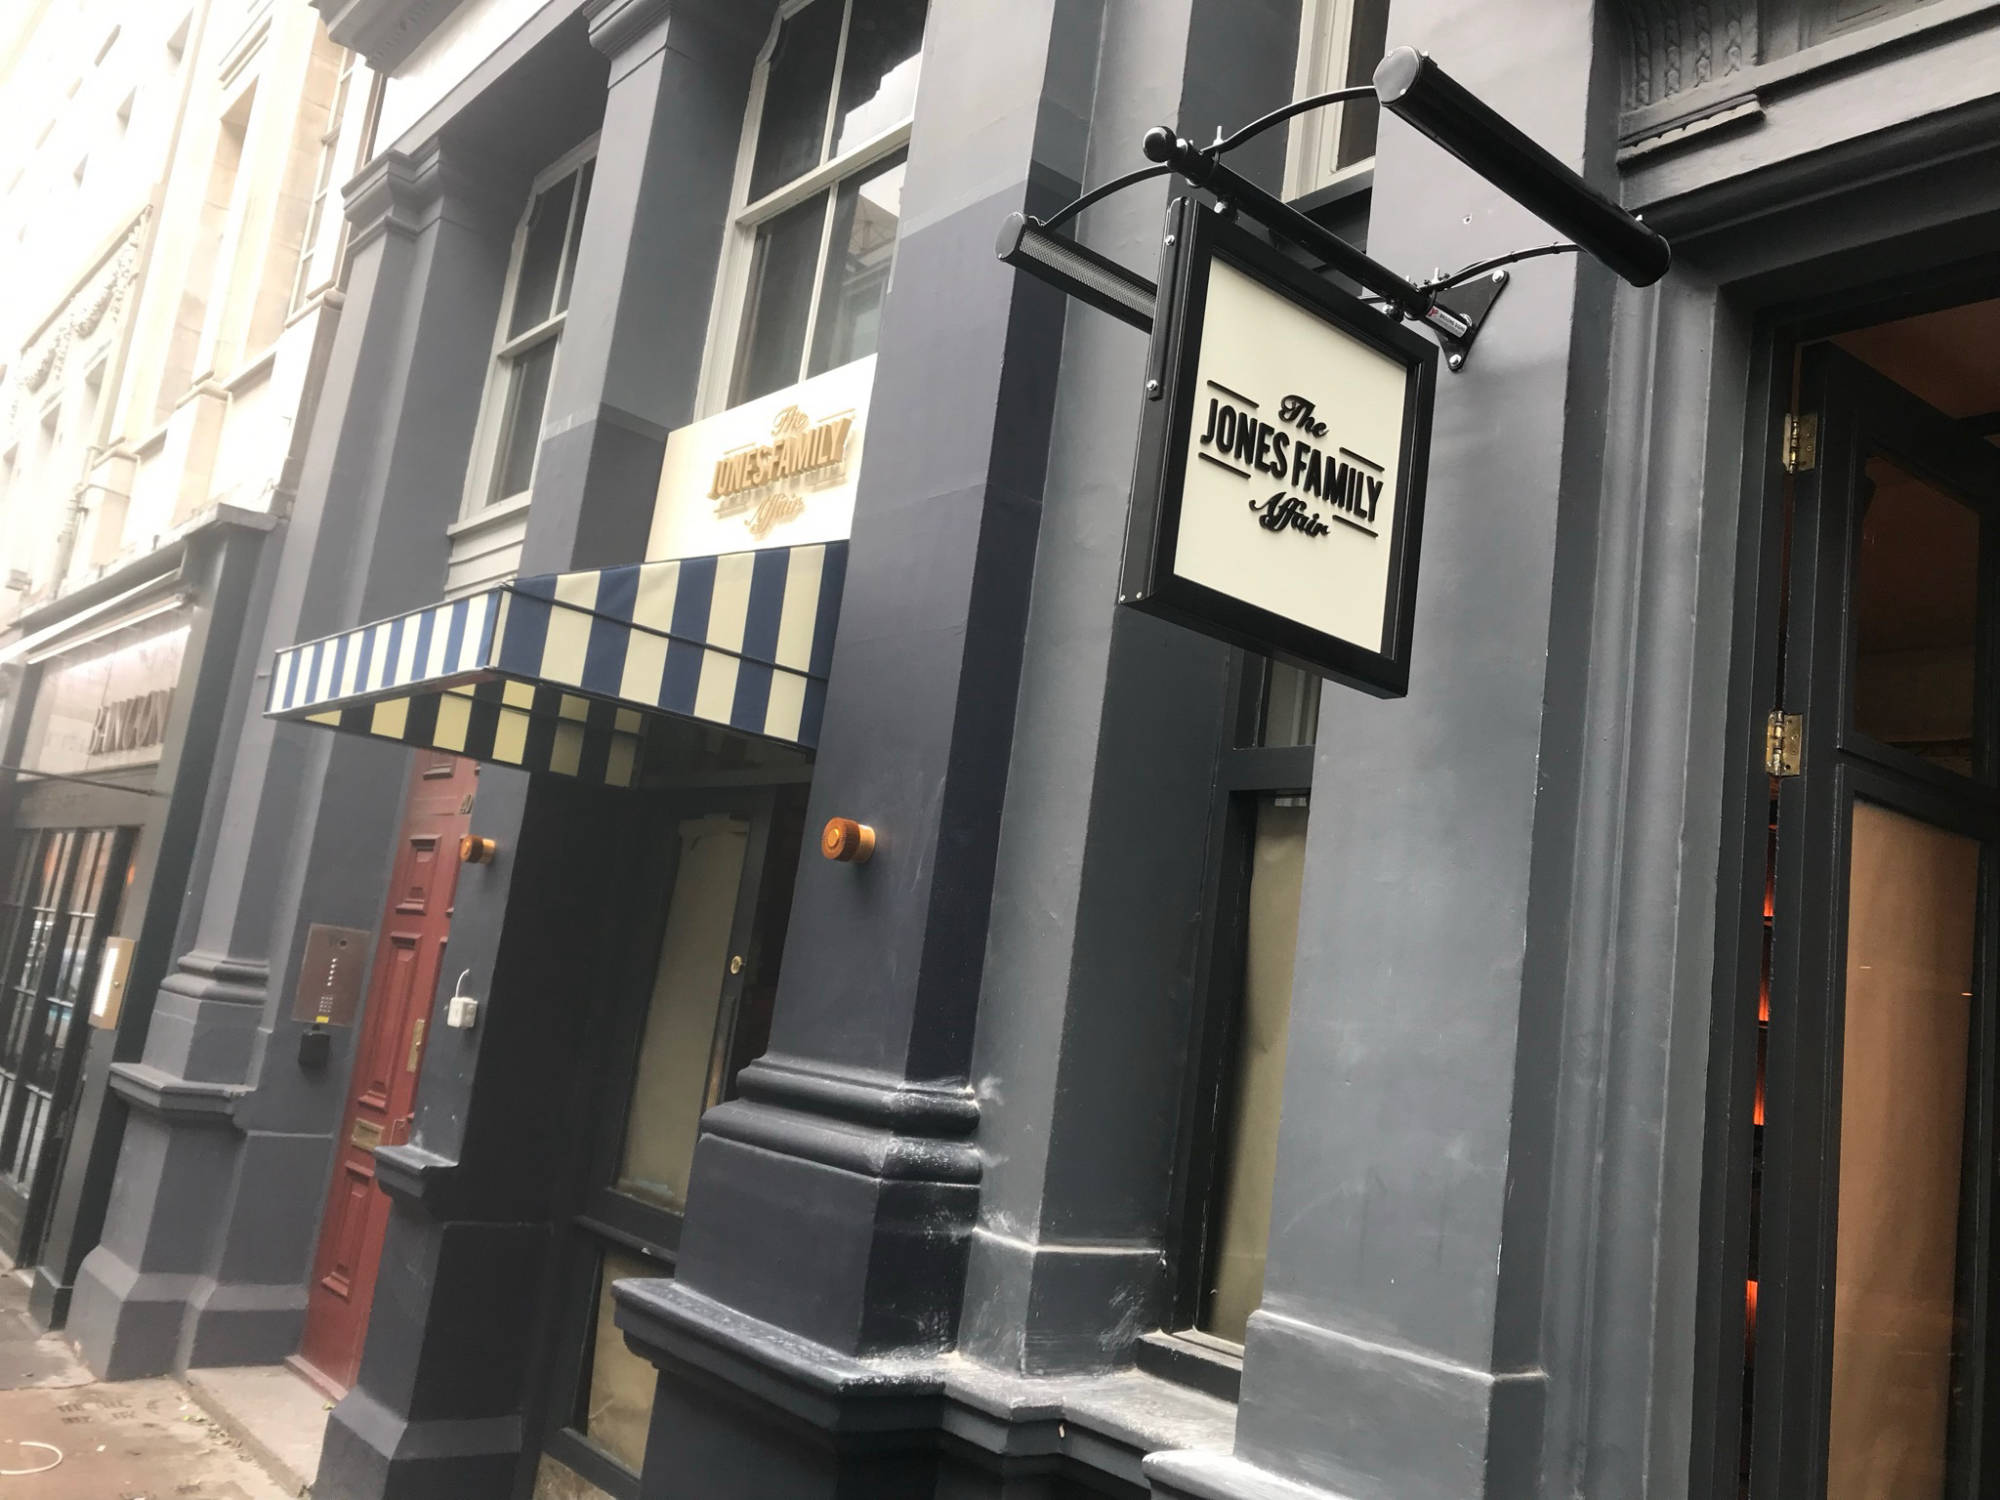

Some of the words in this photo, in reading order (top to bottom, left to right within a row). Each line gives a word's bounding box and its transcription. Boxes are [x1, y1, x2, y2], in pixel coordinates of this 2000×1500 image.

[771, 405, 810, 436] The
[1278, 394, 1328, 438] The
[767, 418, 853, 481] FAMILY
[1200, 398, 1290, 480] JONES
[1292, 439, 1384, 522] FAMILY
[1248, 491, 1330, 538] Affair
